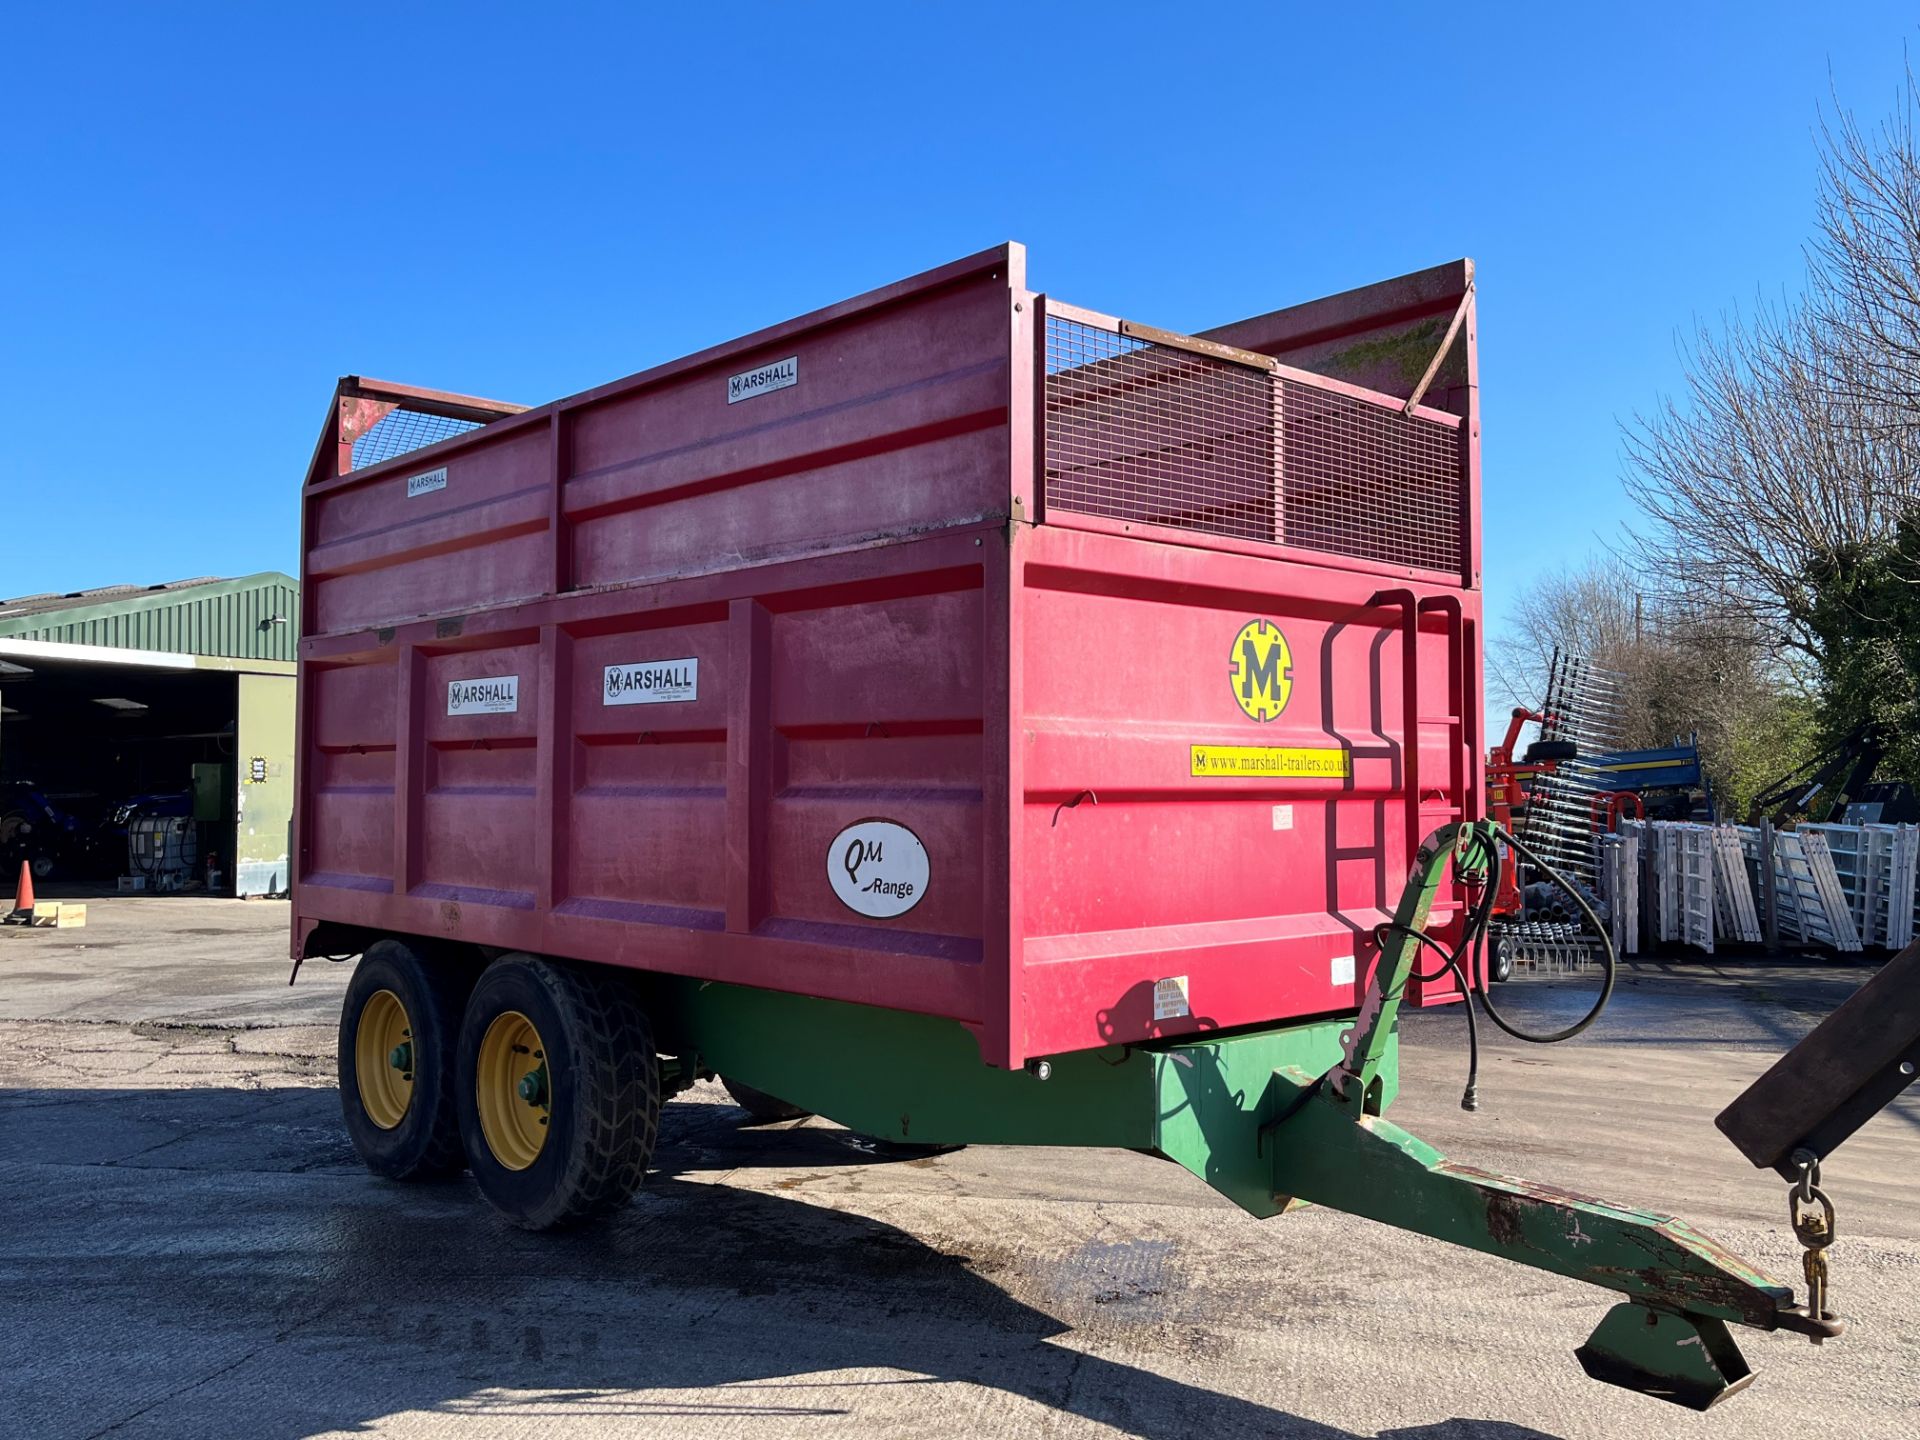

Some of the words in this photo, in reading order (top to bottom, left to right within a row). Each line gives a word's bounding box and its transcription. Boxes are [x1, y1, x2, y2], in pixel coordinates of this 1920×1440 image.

[731, 363, 794, 395] MARSHALL
[607, 666, 692, 695] MARSHALL
[1242, 639, 1281, 701] M
[451, 682, 514, 706] MARSHALL
[1210, 753, 1348, 772] www.marshall-trailers.co.uk
[844, 839, 883, 884] QM
[871, 877, 914, 899] Range
